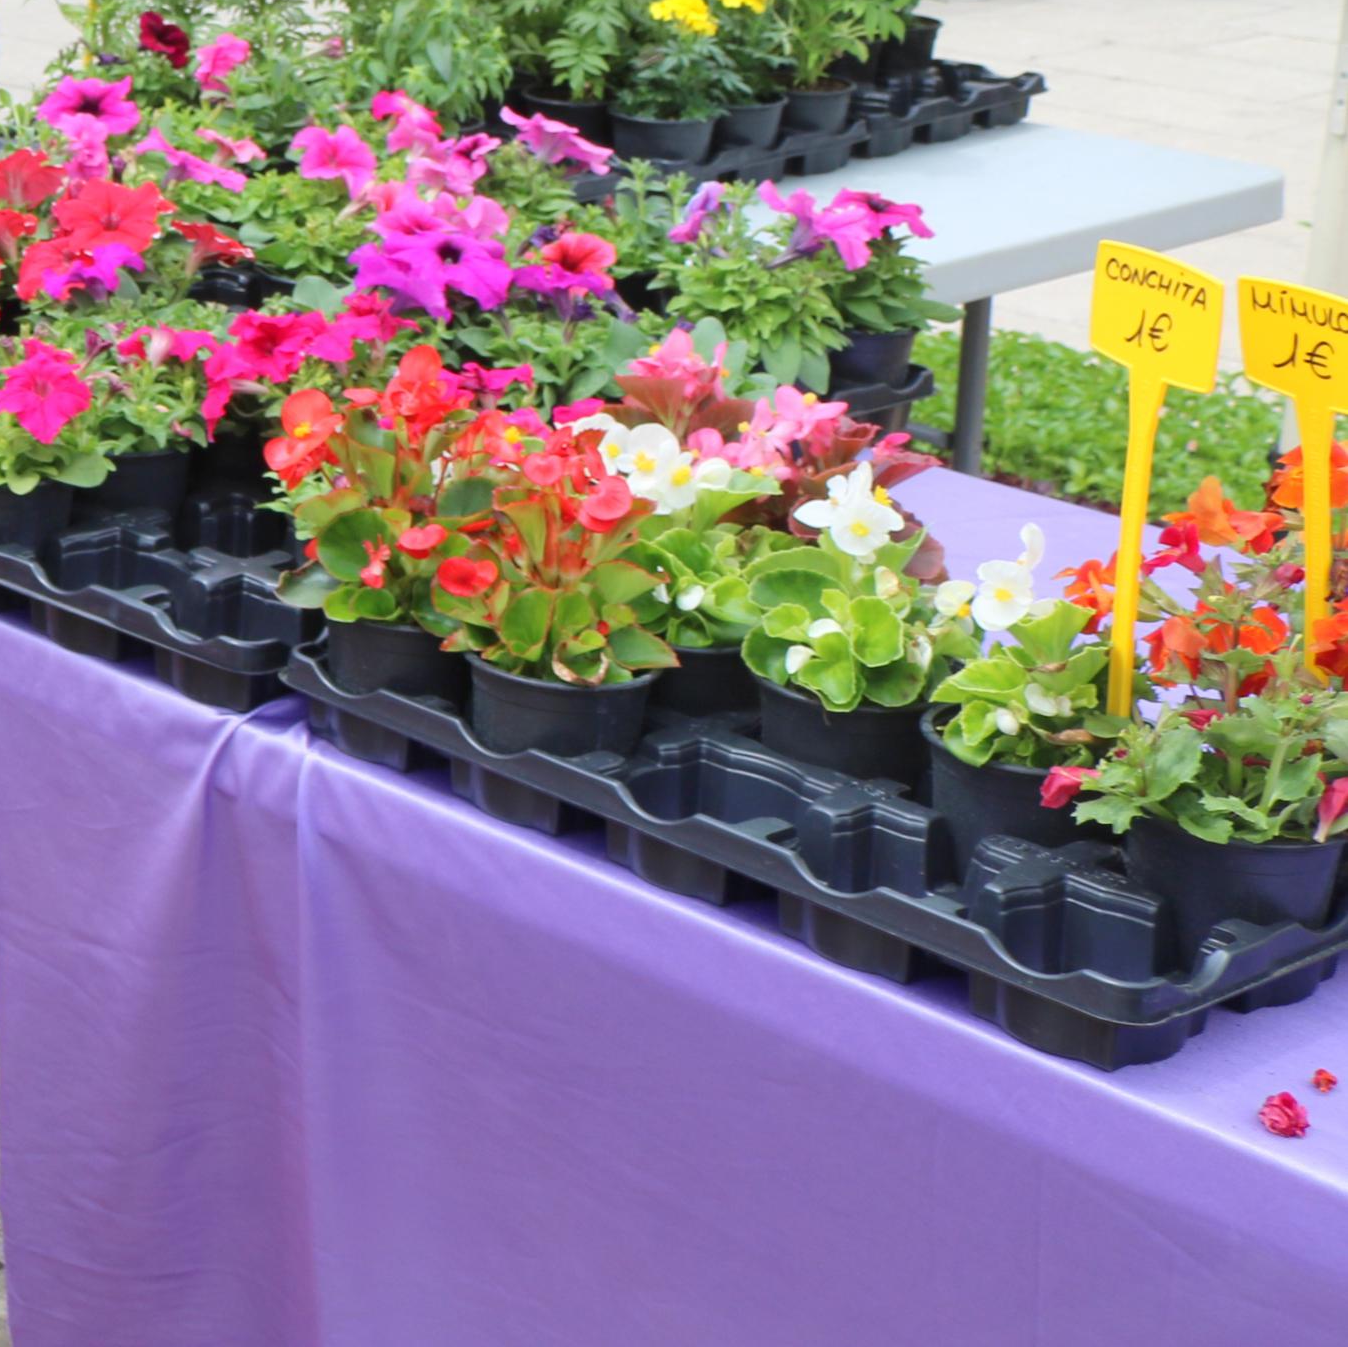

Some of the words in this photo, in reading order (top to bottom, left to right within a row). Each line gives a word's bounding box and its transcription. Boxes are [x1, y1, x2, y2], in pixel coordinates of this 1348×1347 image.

[1105, 257, 1207, 311] CONCHITA
[1125, 309, 1173, 352] 1€
[1272, 332, 1335, 380] 1€
